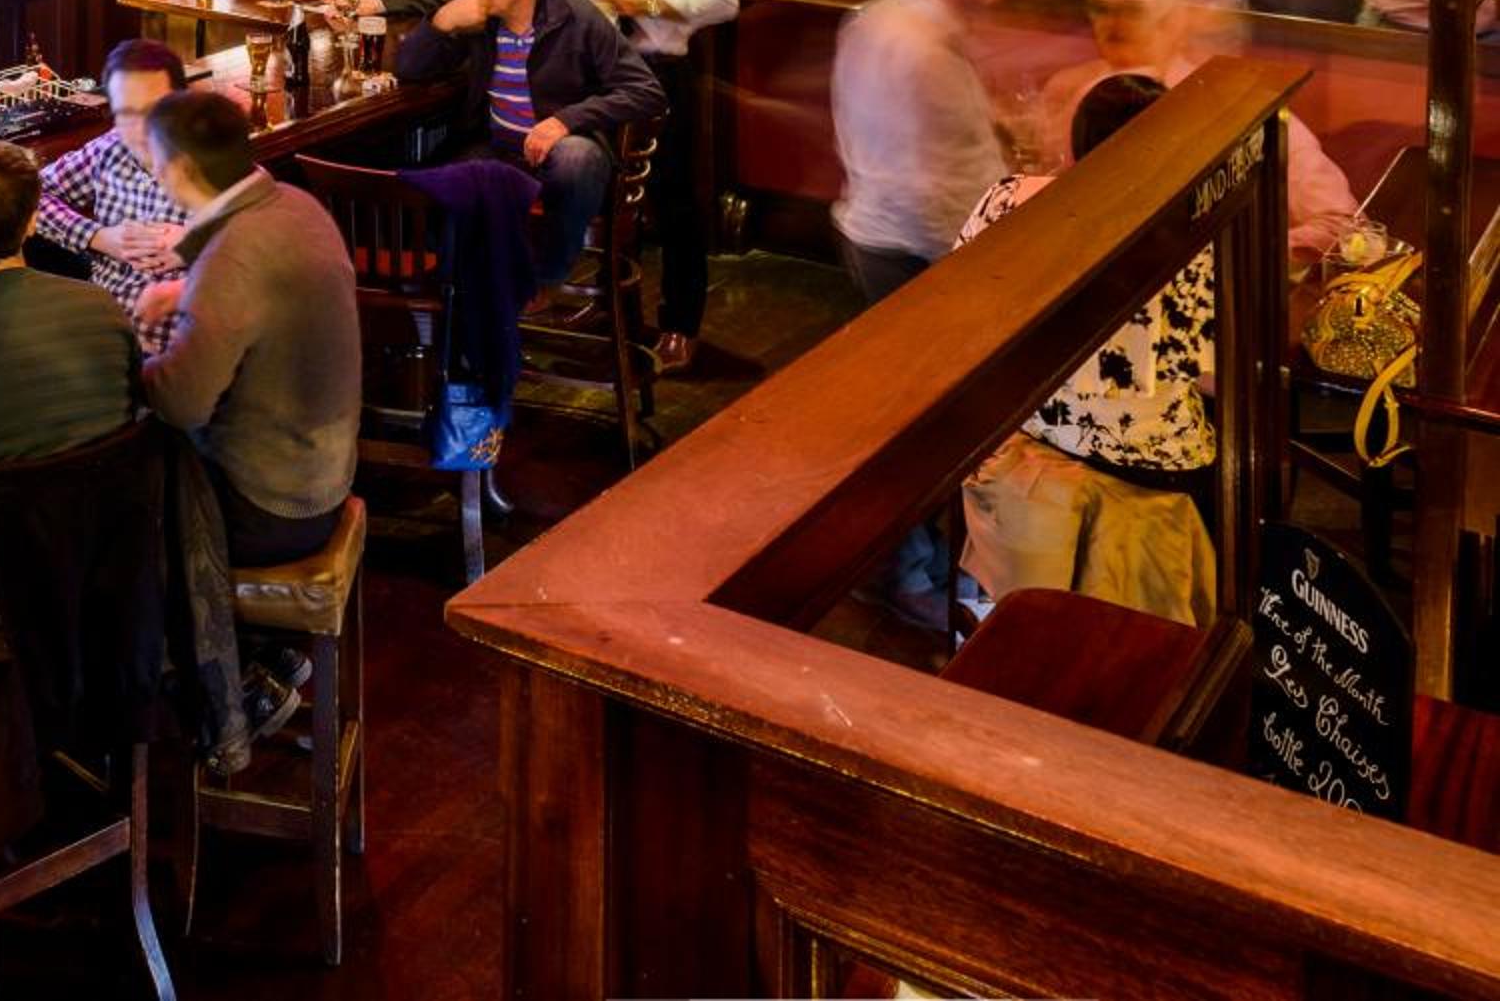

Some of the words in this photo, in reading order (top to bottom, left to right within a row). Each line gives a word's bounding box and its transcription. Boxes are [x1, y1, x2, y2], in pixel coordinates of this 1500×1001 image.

[1290, 568, 1369, 654] GUINNESS
[1294, 626, 1313, 654] of
[1311, 638, 1333, 677] the
[1333, 667, 1390, 726] Month
[1315, 695, 1390, 800] Chaises
